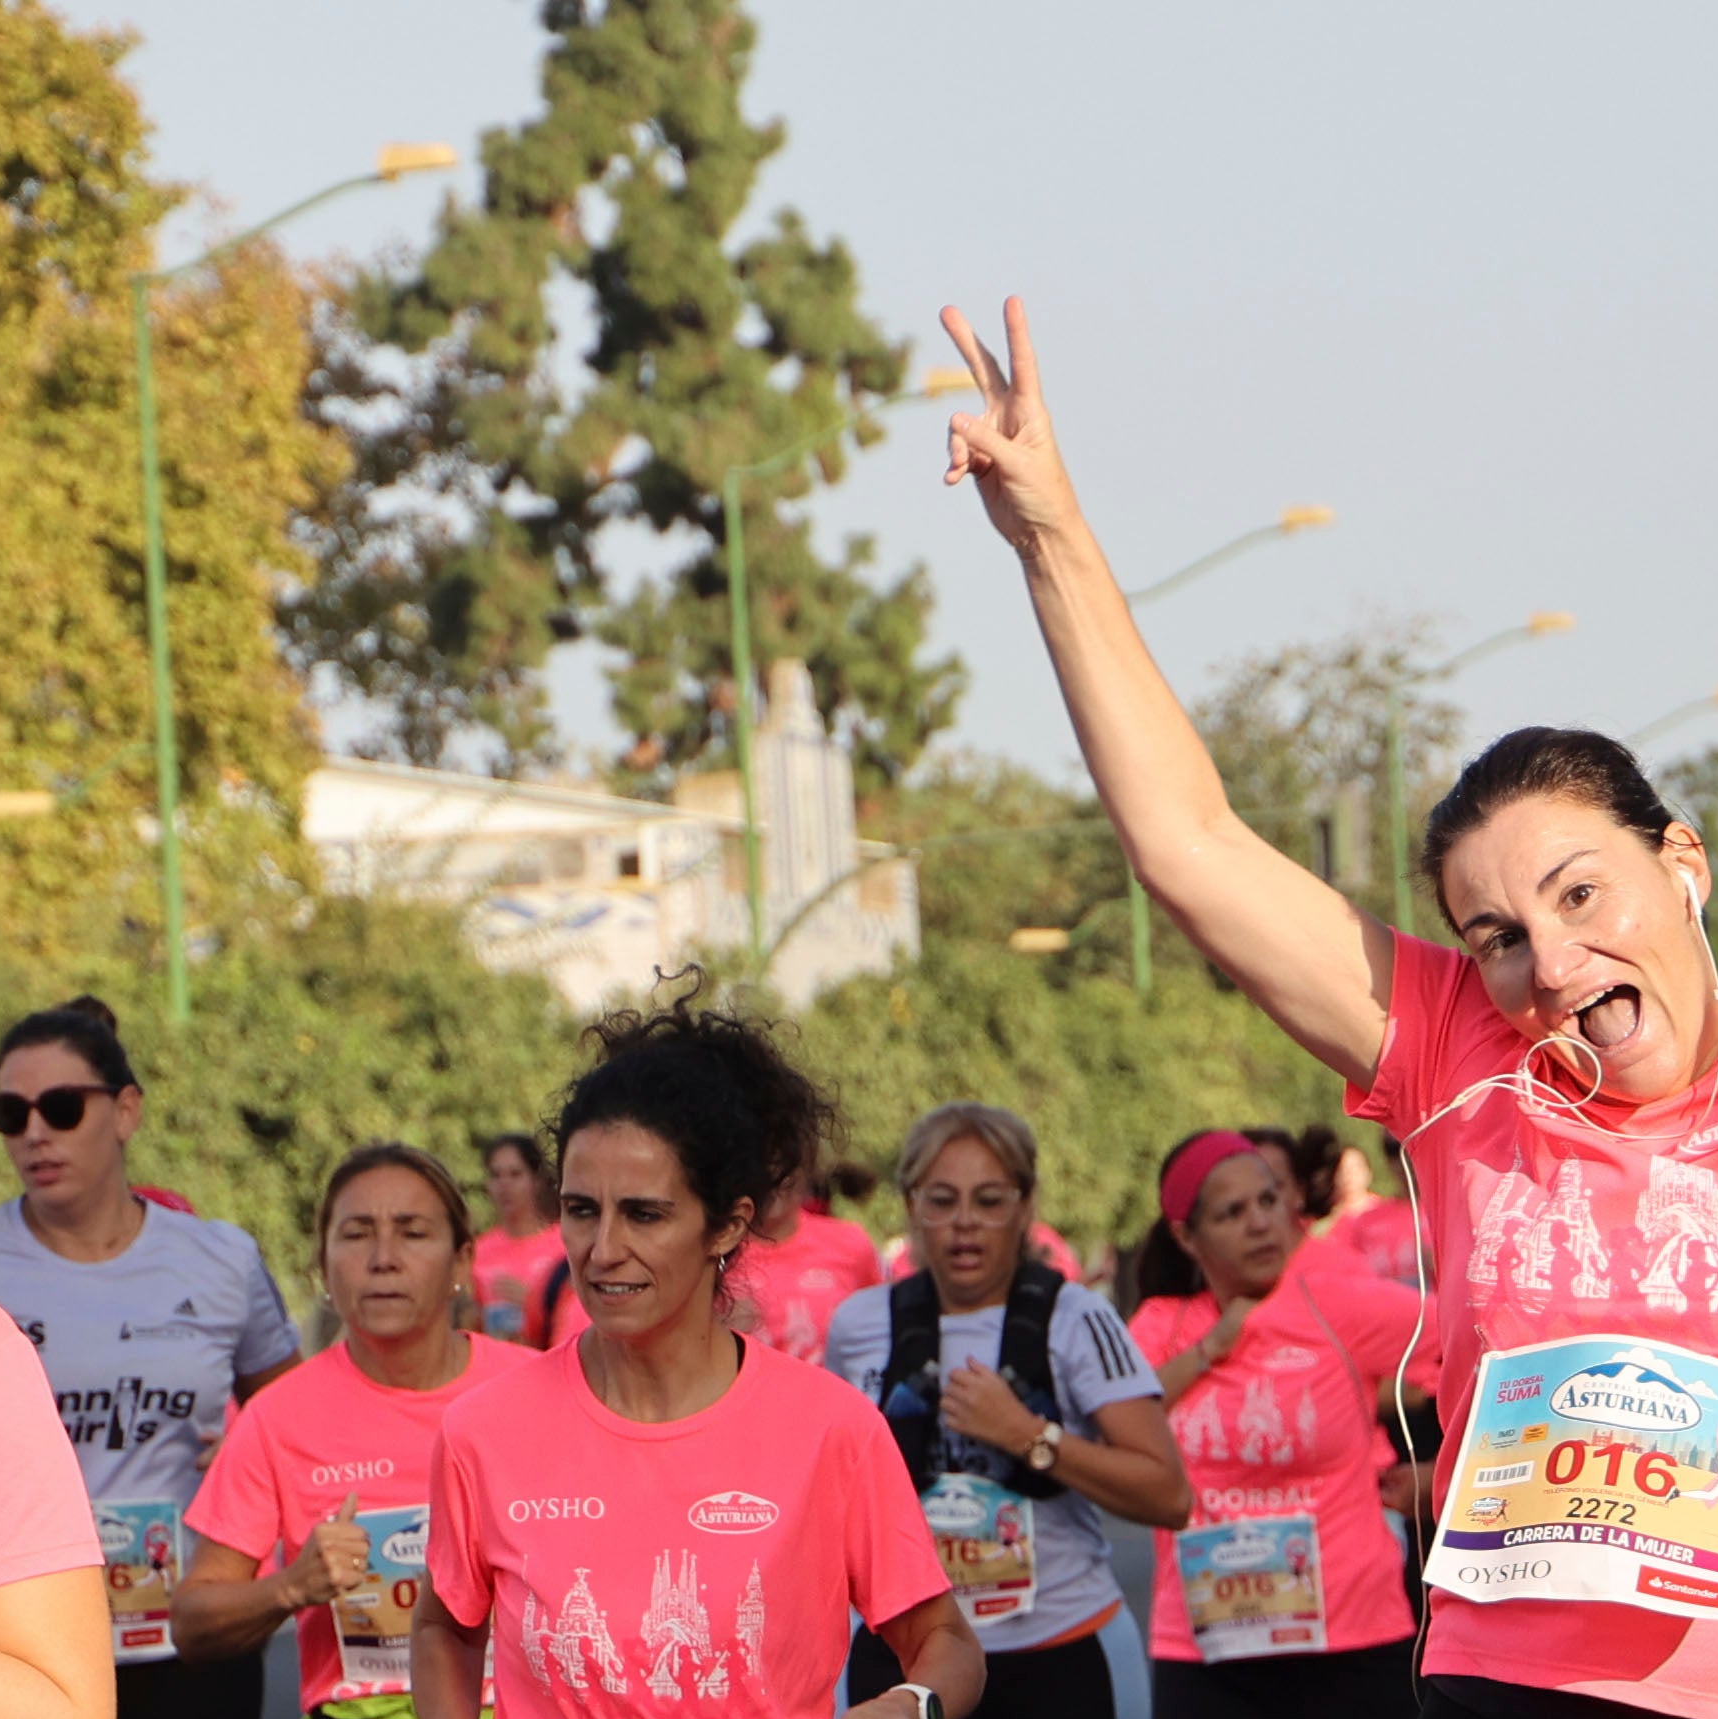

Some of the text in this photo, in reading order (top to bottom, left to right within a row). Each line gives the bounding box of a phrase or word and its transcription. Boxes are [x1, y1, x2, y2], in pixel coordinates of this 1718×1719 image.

[1496, 1385, 1543, 1404] SUMA
[1498, 1374, 1545, 1390] TU DORSAL
[1558, 1384, 1689, 1425] ASTURIANA
[312, 1458, 395, 1488] OYSHO
[1545, 1439, 1680, 1498] 016
[508, 1497, 605, 1524] OYSHO
[1201, 1482, 1317, 1513] DORSAL
[1565, 1497, 1638, 1526] 2272
[696, 1506, 773, 1524] ASTURIANA
[1503, 1524, 1695, 1564] CARRERA DE LA MUJER
[1457, 1559, 1553, 1585] OYSHO
